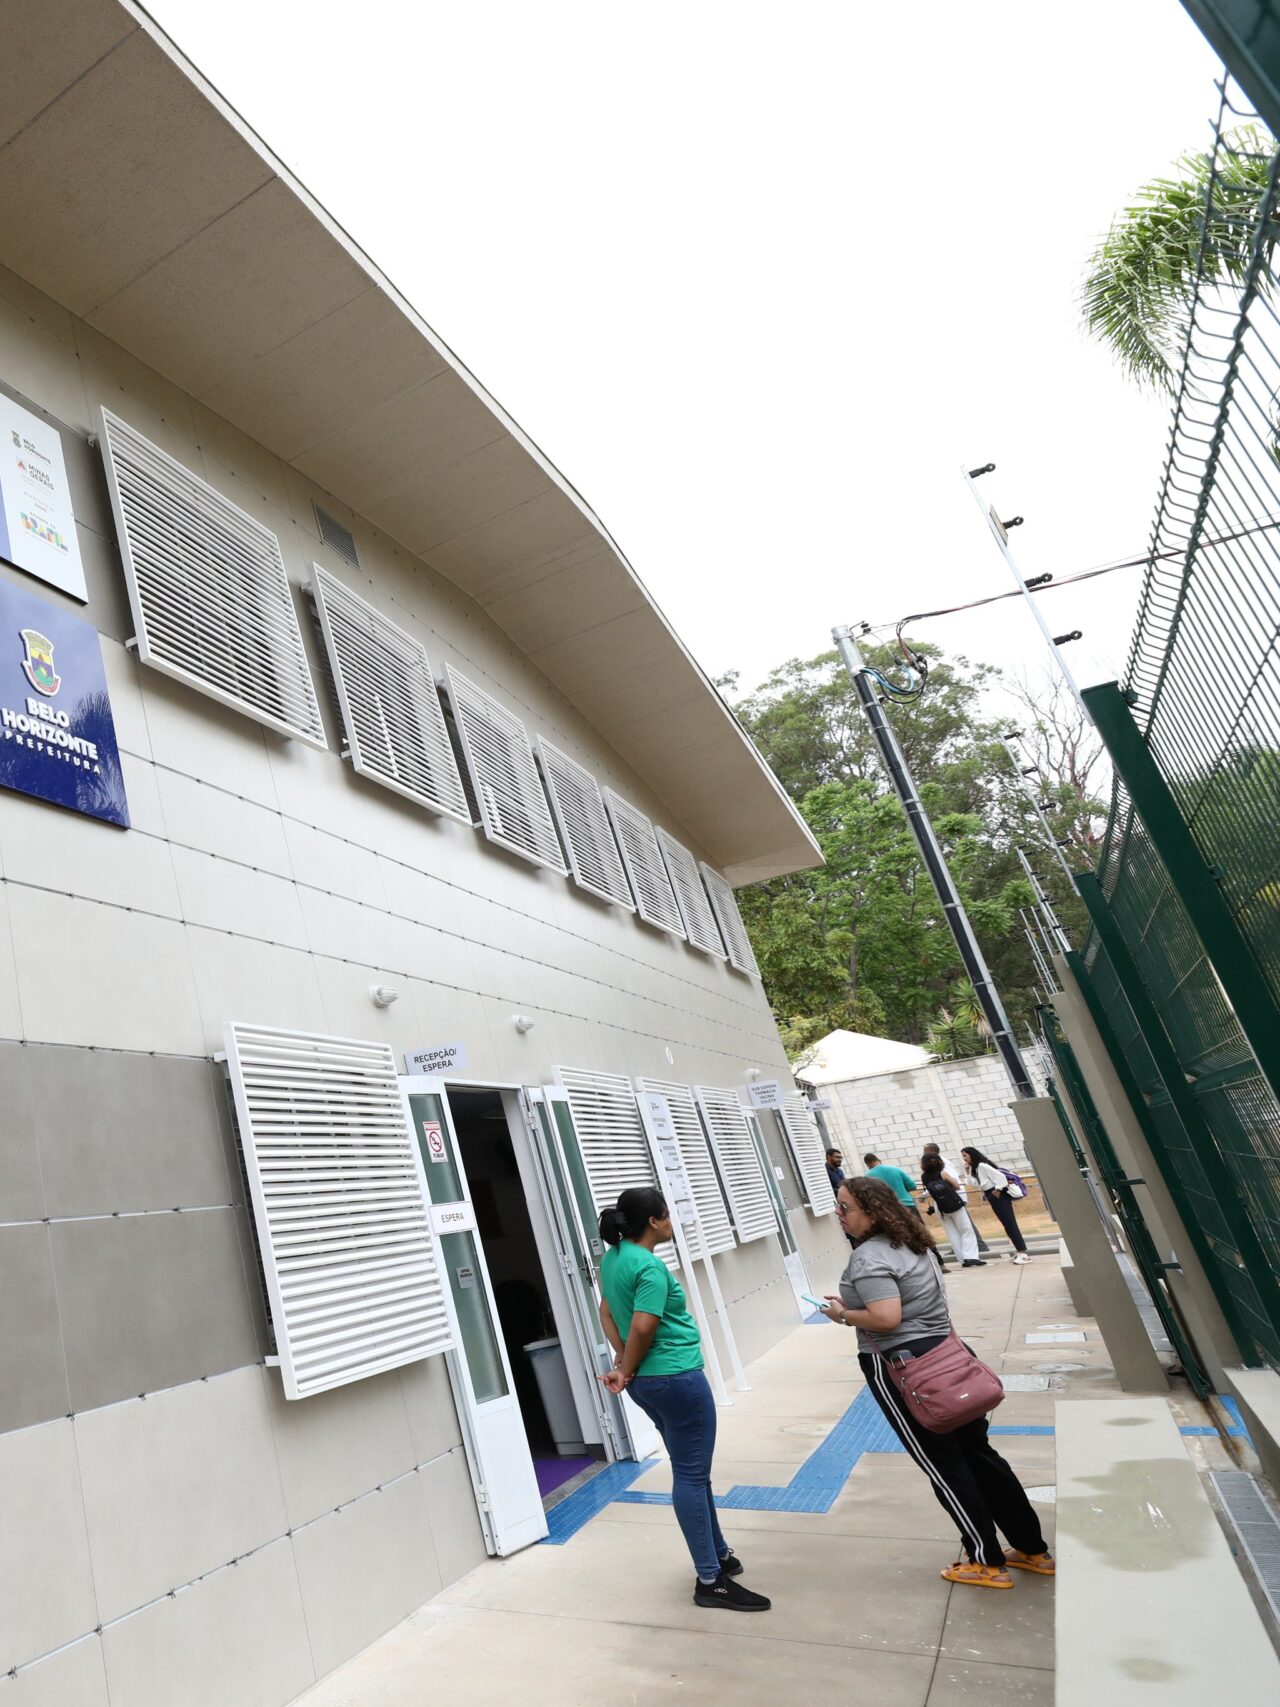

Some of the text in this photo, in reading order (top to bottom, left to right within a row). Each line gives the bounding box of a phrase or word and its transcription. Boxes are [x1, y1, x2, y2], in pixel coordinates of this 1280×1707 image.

[25, 697, 70, 728] BELO
[1, 707, 99, 760] HORIZONTE
[5, 730, 101, 774] PREFEITURA
[413, 1047, 457, 1063] RECEPÇÃO/
[422, 1059, 453, 1072] ESPERA
[441, 1212, 464, 1223] ESPERA
